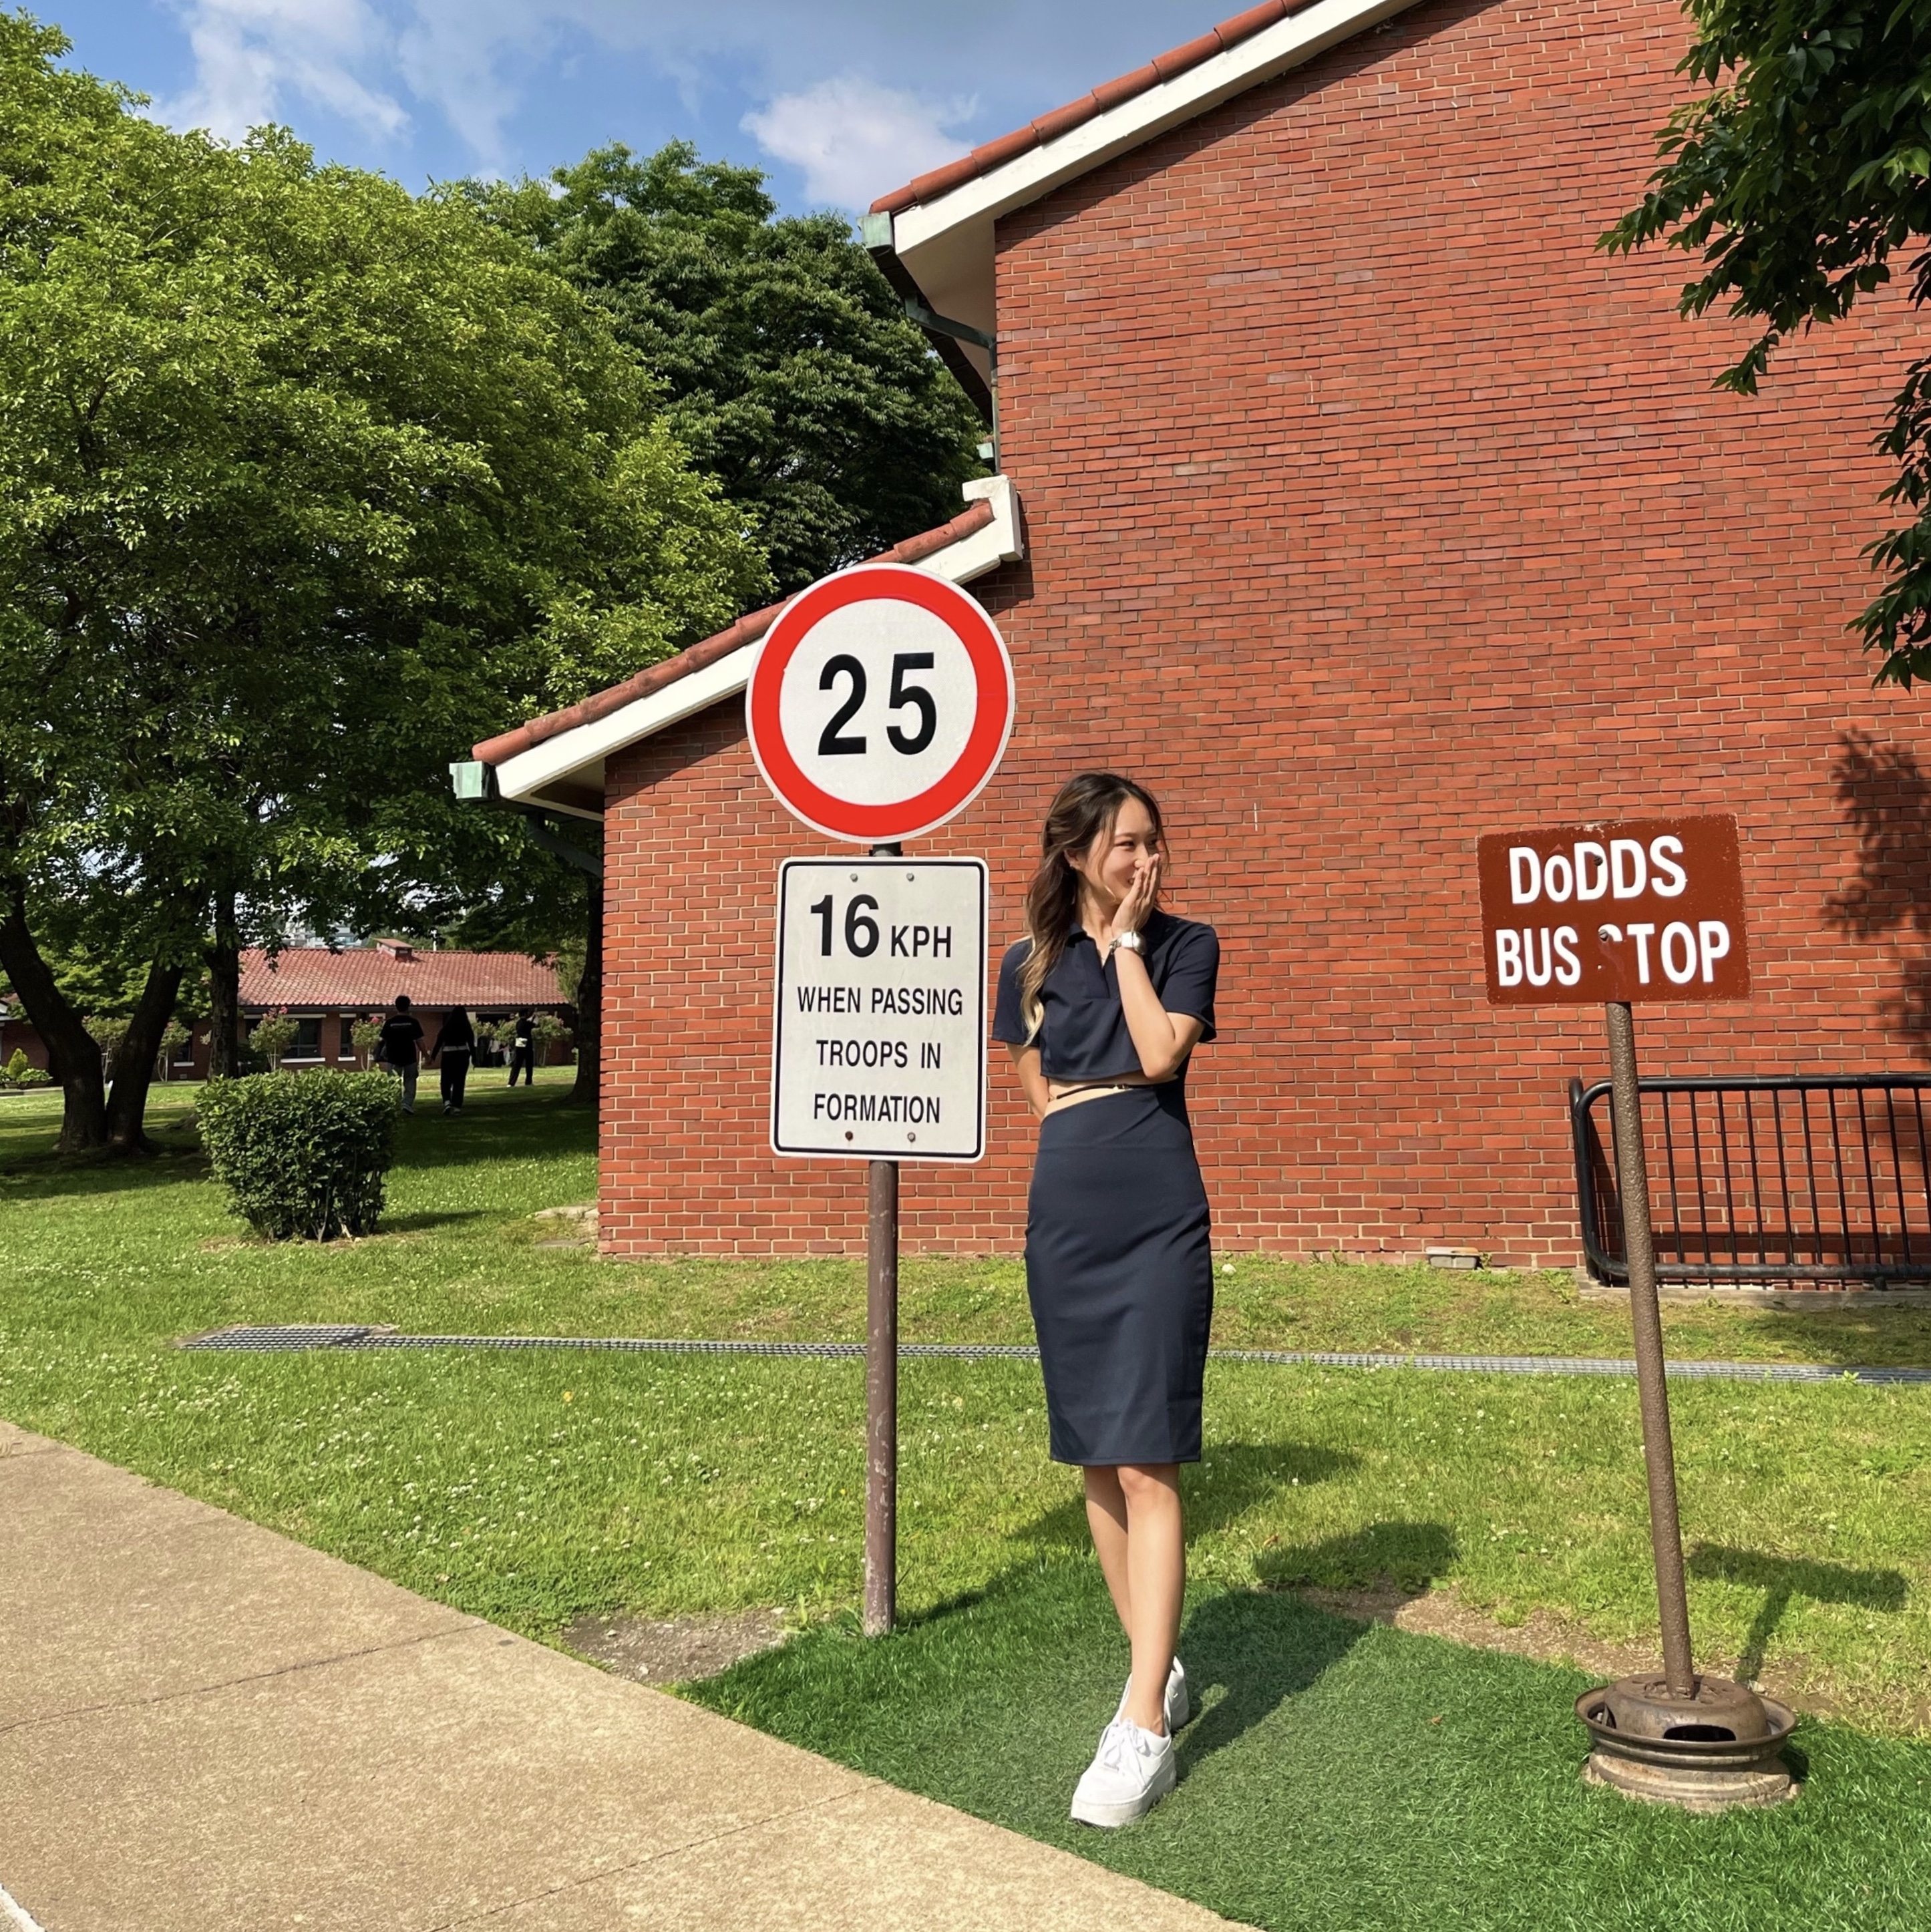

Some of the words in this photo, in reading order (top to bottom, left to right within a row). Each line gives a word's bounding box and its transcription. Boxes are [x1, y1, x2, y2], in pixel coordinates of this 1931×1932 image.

[818, 652, 936, 755] 25
[1509, 835, 1688, 904] DoDDS
[810, 894, 880, 958] 16
[890, 925, 952, 958] KPH
[1495, 926, 1581, 986] BUS
[797, 986, 861, 1013] WHEN
[872, 987, 962, 1016] PASSING
[816, 1039, 908, 1069] TROOPS
[921, 1042, 941, 1069] IN
[814, 1093, 940, 1124] FORMATION
